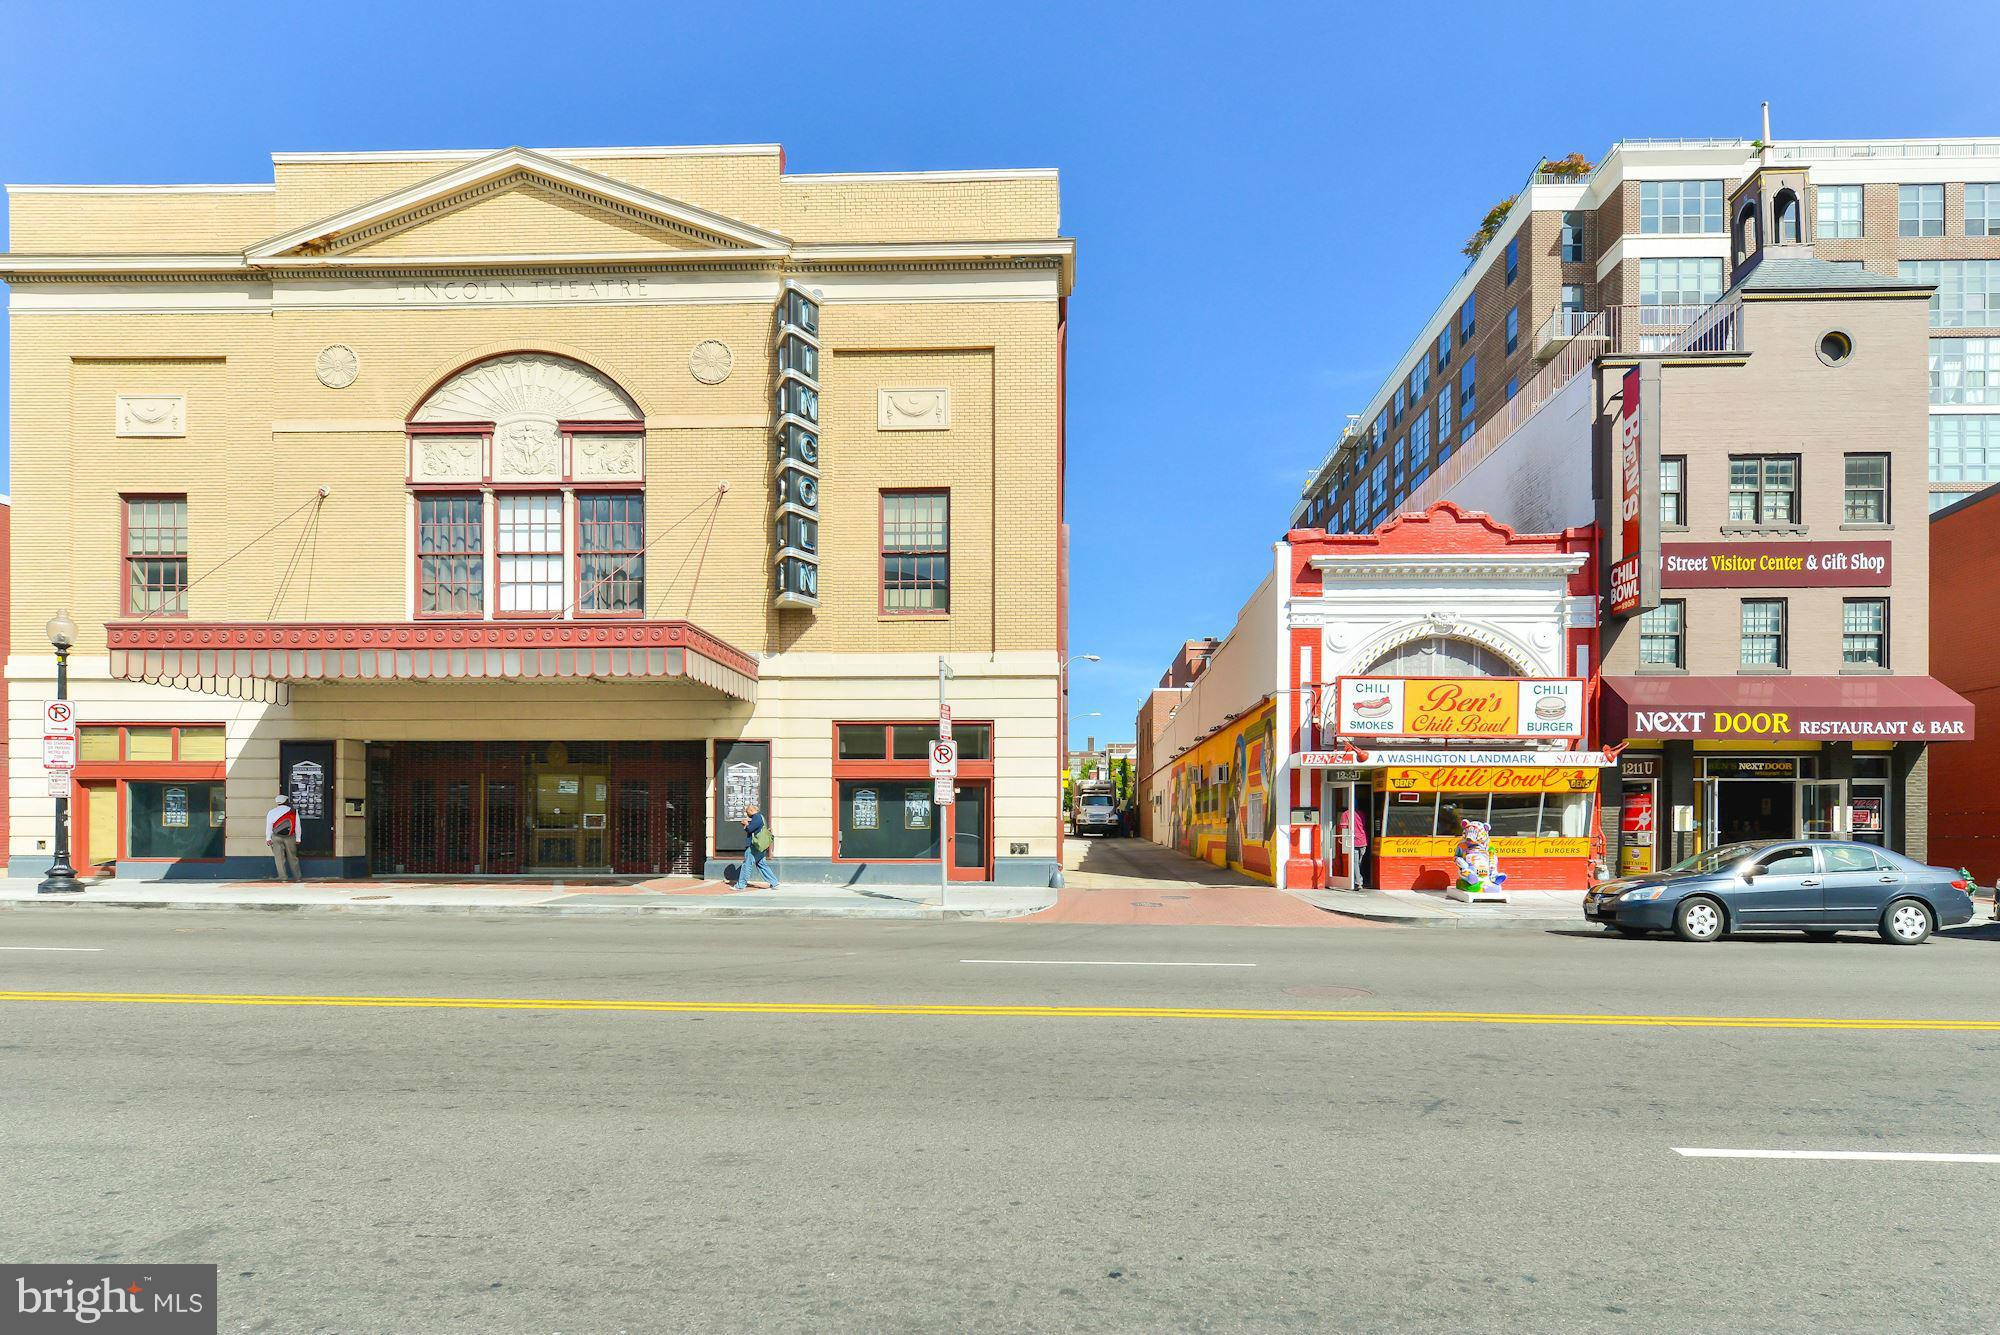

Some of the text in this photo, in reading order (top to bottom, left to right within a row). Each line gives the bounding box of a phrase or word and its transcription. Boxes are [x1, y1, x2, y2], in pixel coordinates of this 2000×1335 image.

[397, 278, 649, 300] LINCOLN THEATRE
[799, 298, 819, 596] LINCOLN
[1611, 559, 1639, 587] CHILI
[1667, 556, 1708, 571] Street
[1711, 555, 1757, 571] Visitor
[1759, 554, 1804, 571] Center
[1806, 554, 1819, 570] &
[1821, 553, 1848, 570] Gift
[1850, 552, 1885, 573] Shop
[1611, 579, 1640, 605] BOWL
[1355, 683, 1390, 693] CHILI
[1419, 684, 1503, 713] Ben's
[1533, 685, 1569, 695] CHILI
[1349, 720, 1394, 730] SMOKES
[1411, 714, 1512, 733] Chili Bowl
[1527, 722, 1573, 732] BURGER
[1713, 712, 1792, 734] DOOR
[1800, 721, 1908, 735] RESTAURANT
[1912, 721, 1927, 734] &
[1930, 721, 1965, 734] BAR
[1376, 754, 1385, 763] A
[1387, 754, 1468, 763] WASHINGTON
[1470, 754, 1536, 764] LANDMARK
[1555, 754, 1592, 764] SINCE
[1621, 762, 1654, 774] 1211 U
[1424, 767, 1560, 788] Chili Bowl
